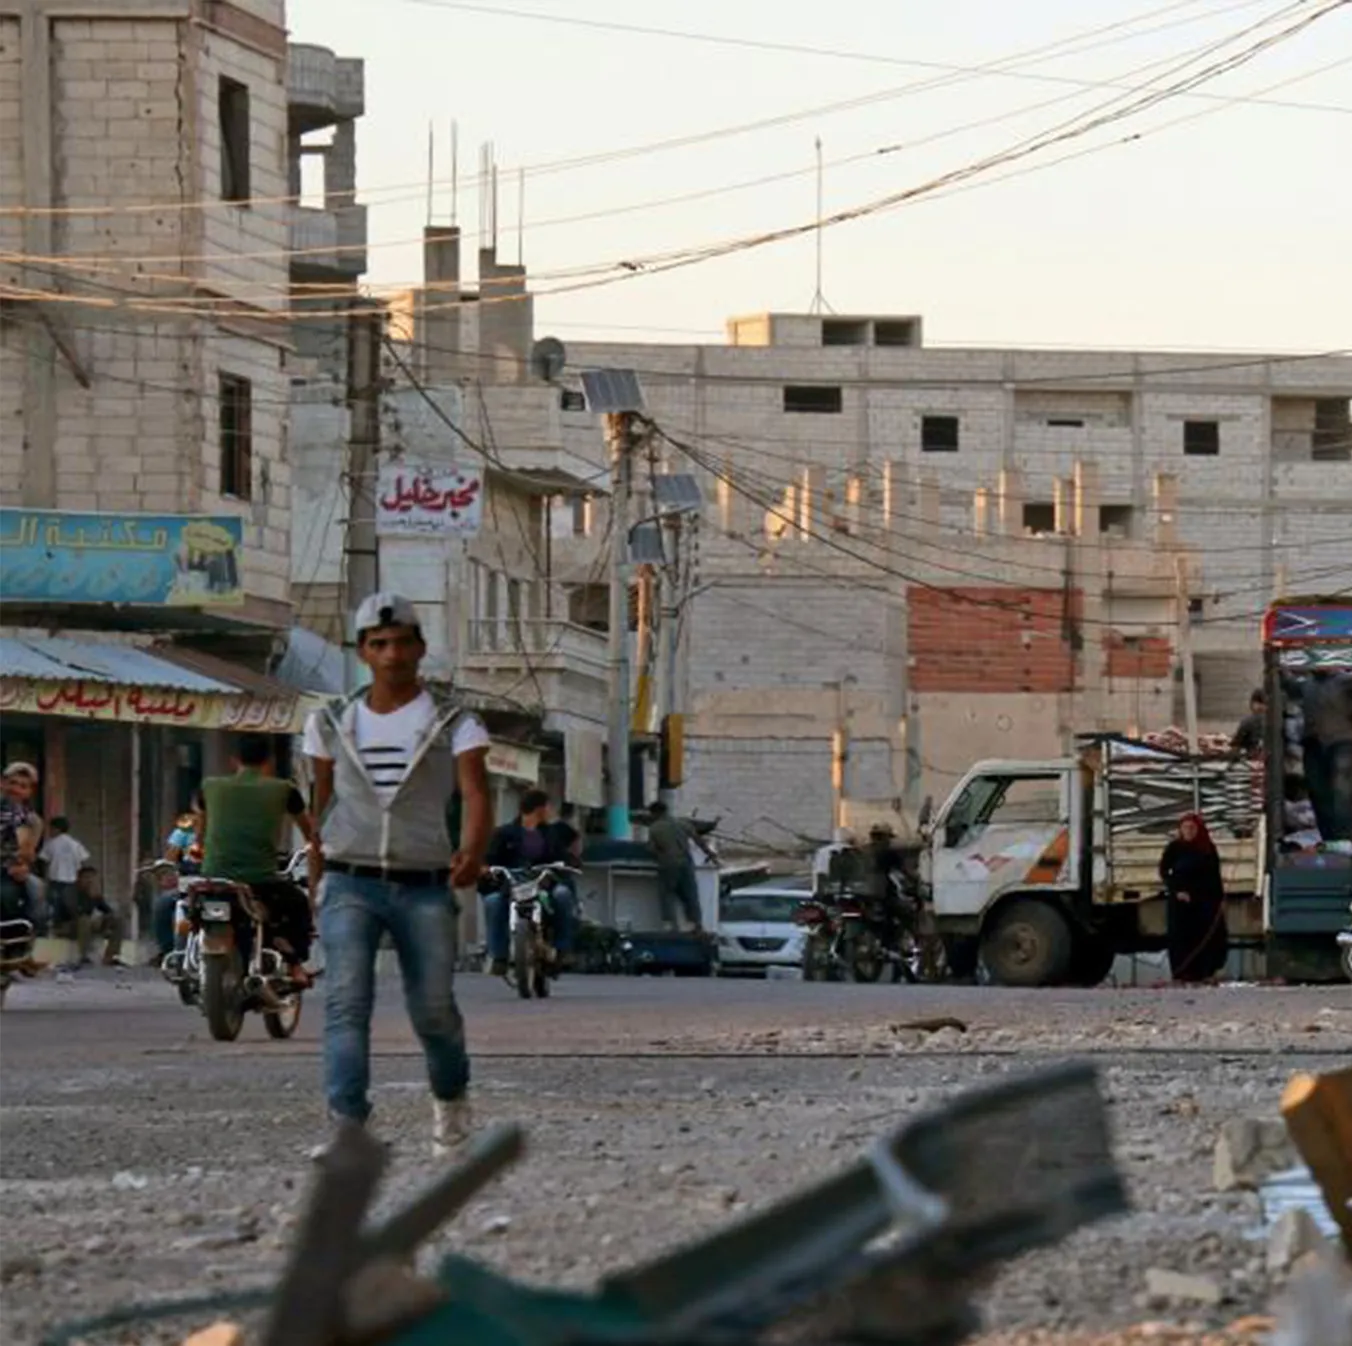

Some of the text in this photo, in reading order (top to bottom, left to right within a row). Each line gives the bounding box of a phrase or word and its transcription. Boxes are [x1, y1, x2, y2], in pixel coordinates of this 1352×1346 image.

[380, 473, 480, 518] مخبر خليل
[45, 516, 169, 557] مكتبة
